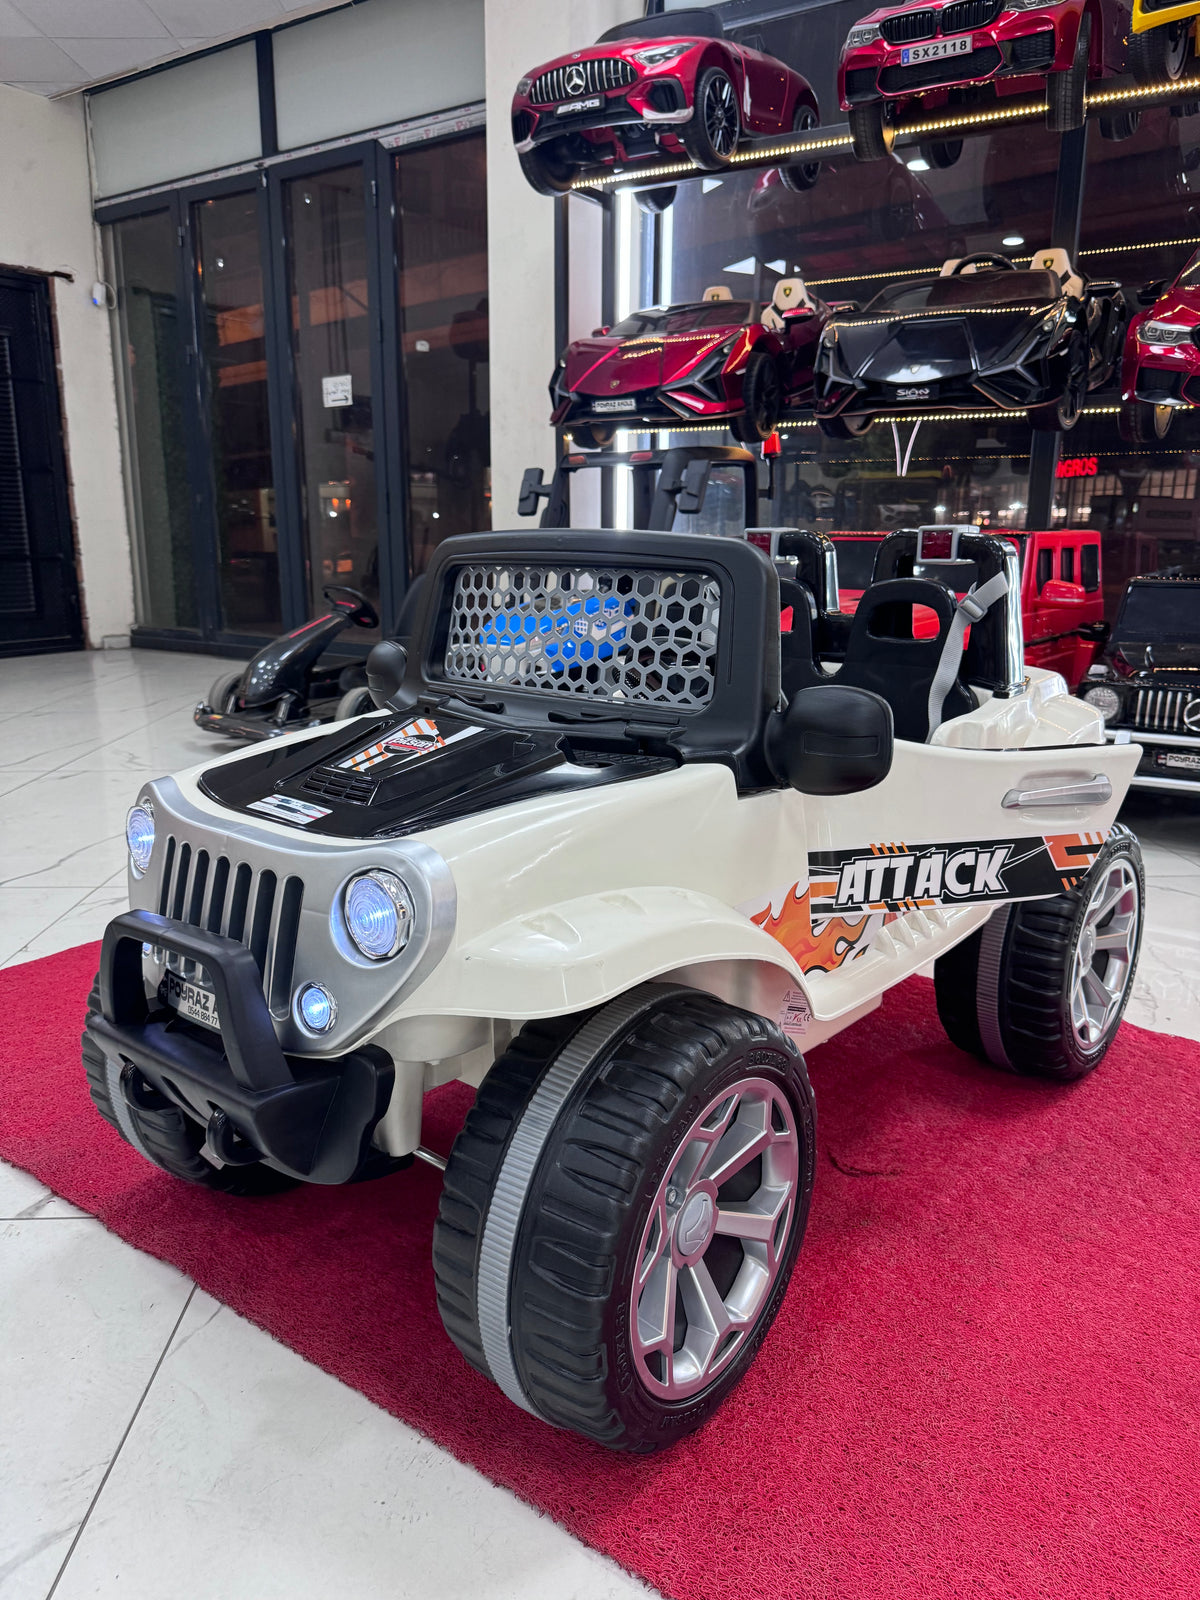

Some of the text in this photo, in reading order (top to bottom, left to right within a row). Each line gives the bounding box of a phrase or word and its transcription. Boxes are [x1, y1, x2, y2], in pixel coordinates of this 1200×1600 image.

[912, 40, 967, 60] SX2118
[837, 848, 1009, 904] ATTACK
[169, 975, 209, 1012] POYRAZ
